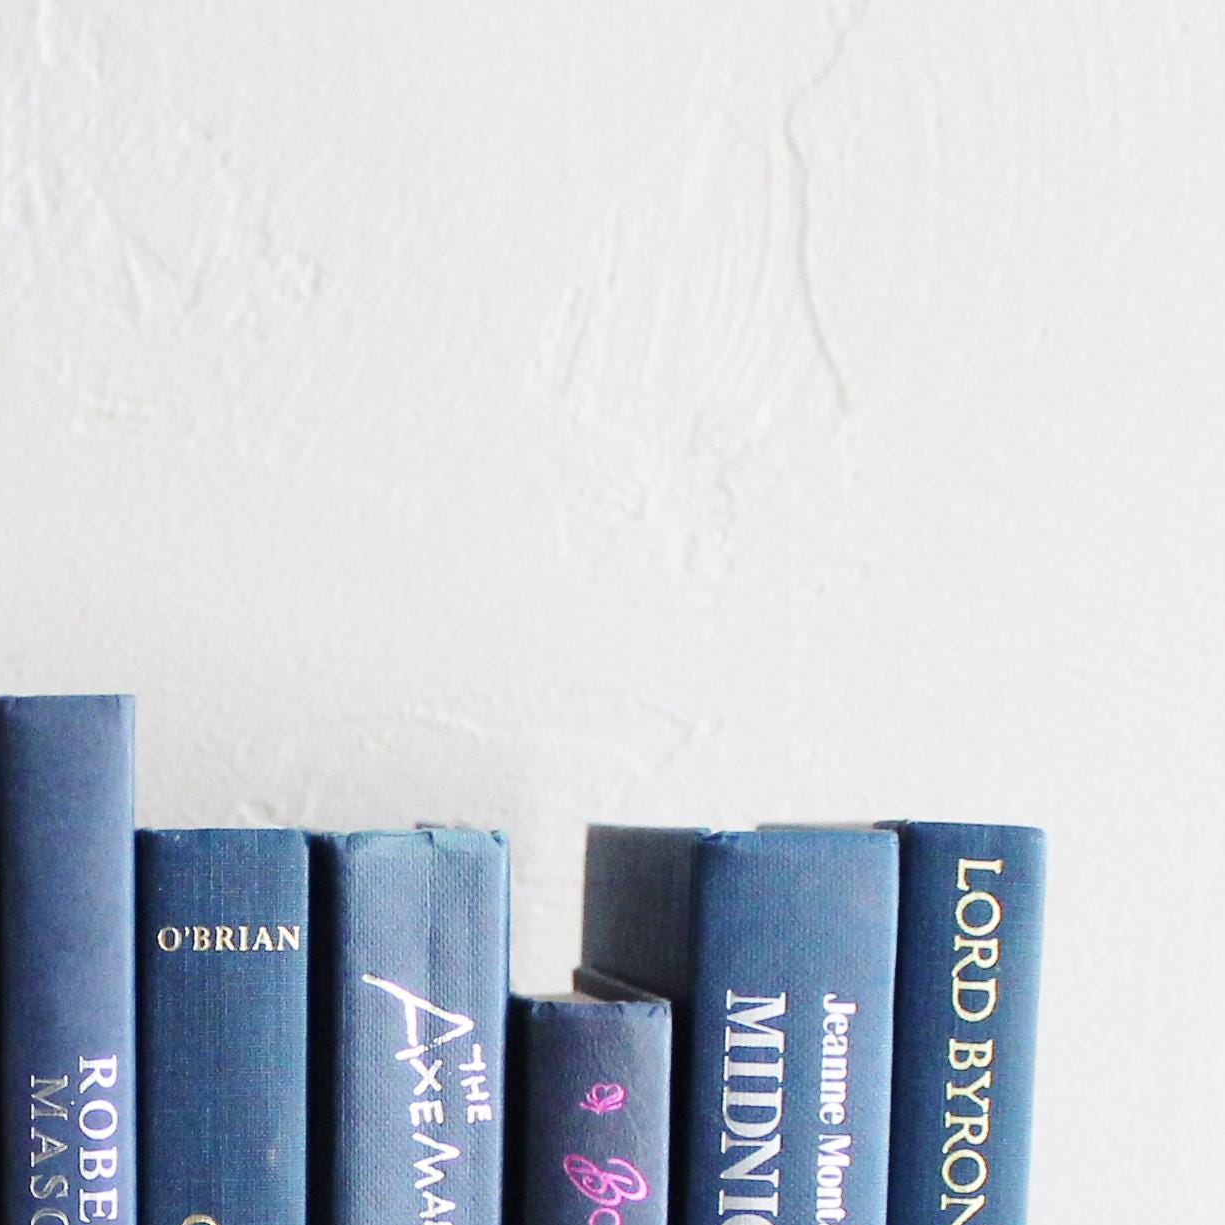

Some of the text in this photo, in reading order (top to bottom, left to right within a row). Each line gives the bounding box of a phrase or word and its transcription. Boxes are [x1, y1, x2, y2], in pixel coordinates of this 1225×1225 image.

[156, 924, 303, 953] O'BRIAN
[951, 857, 1003, 1022] LORD
[458, 1042, 494, 1125] THE
[818, 992, 858, 1127] Jeanne
